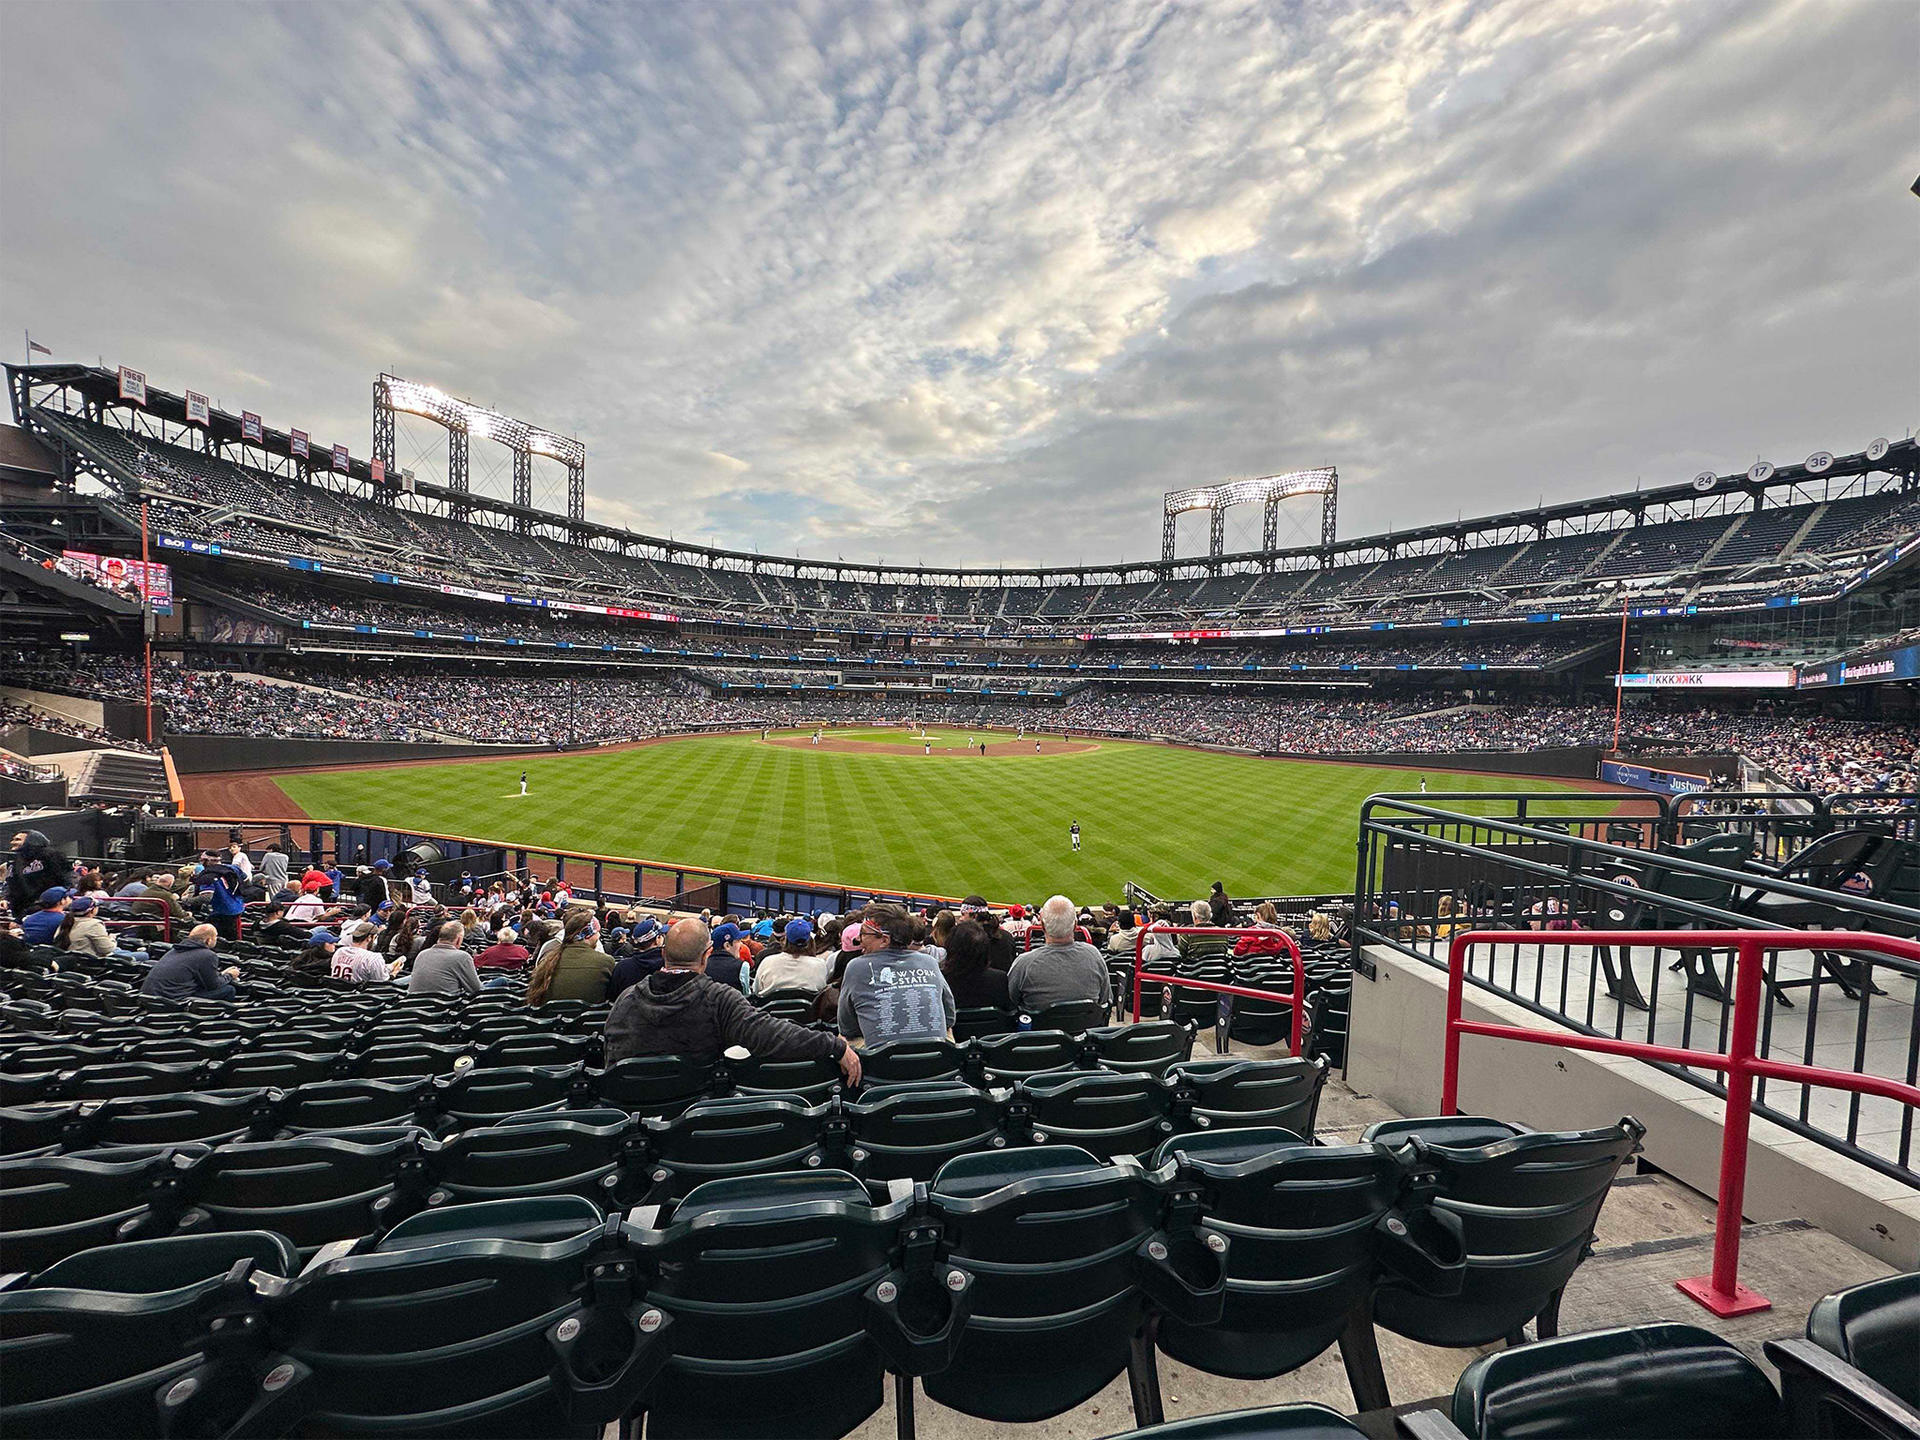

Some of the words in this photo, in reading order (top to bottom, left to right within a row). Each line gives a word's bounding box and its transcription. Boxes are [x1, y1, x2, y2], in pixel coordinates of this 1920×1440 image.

[1872, 443, 1884, 455] 31
[1810, 457, 1827, 467] 36
[1754, 467, 1767, 477] 17
[1699, 476, 1712, 486] 24
[909, 968, 936, 977] YORK
[898, 976, 928, 985] STATE
